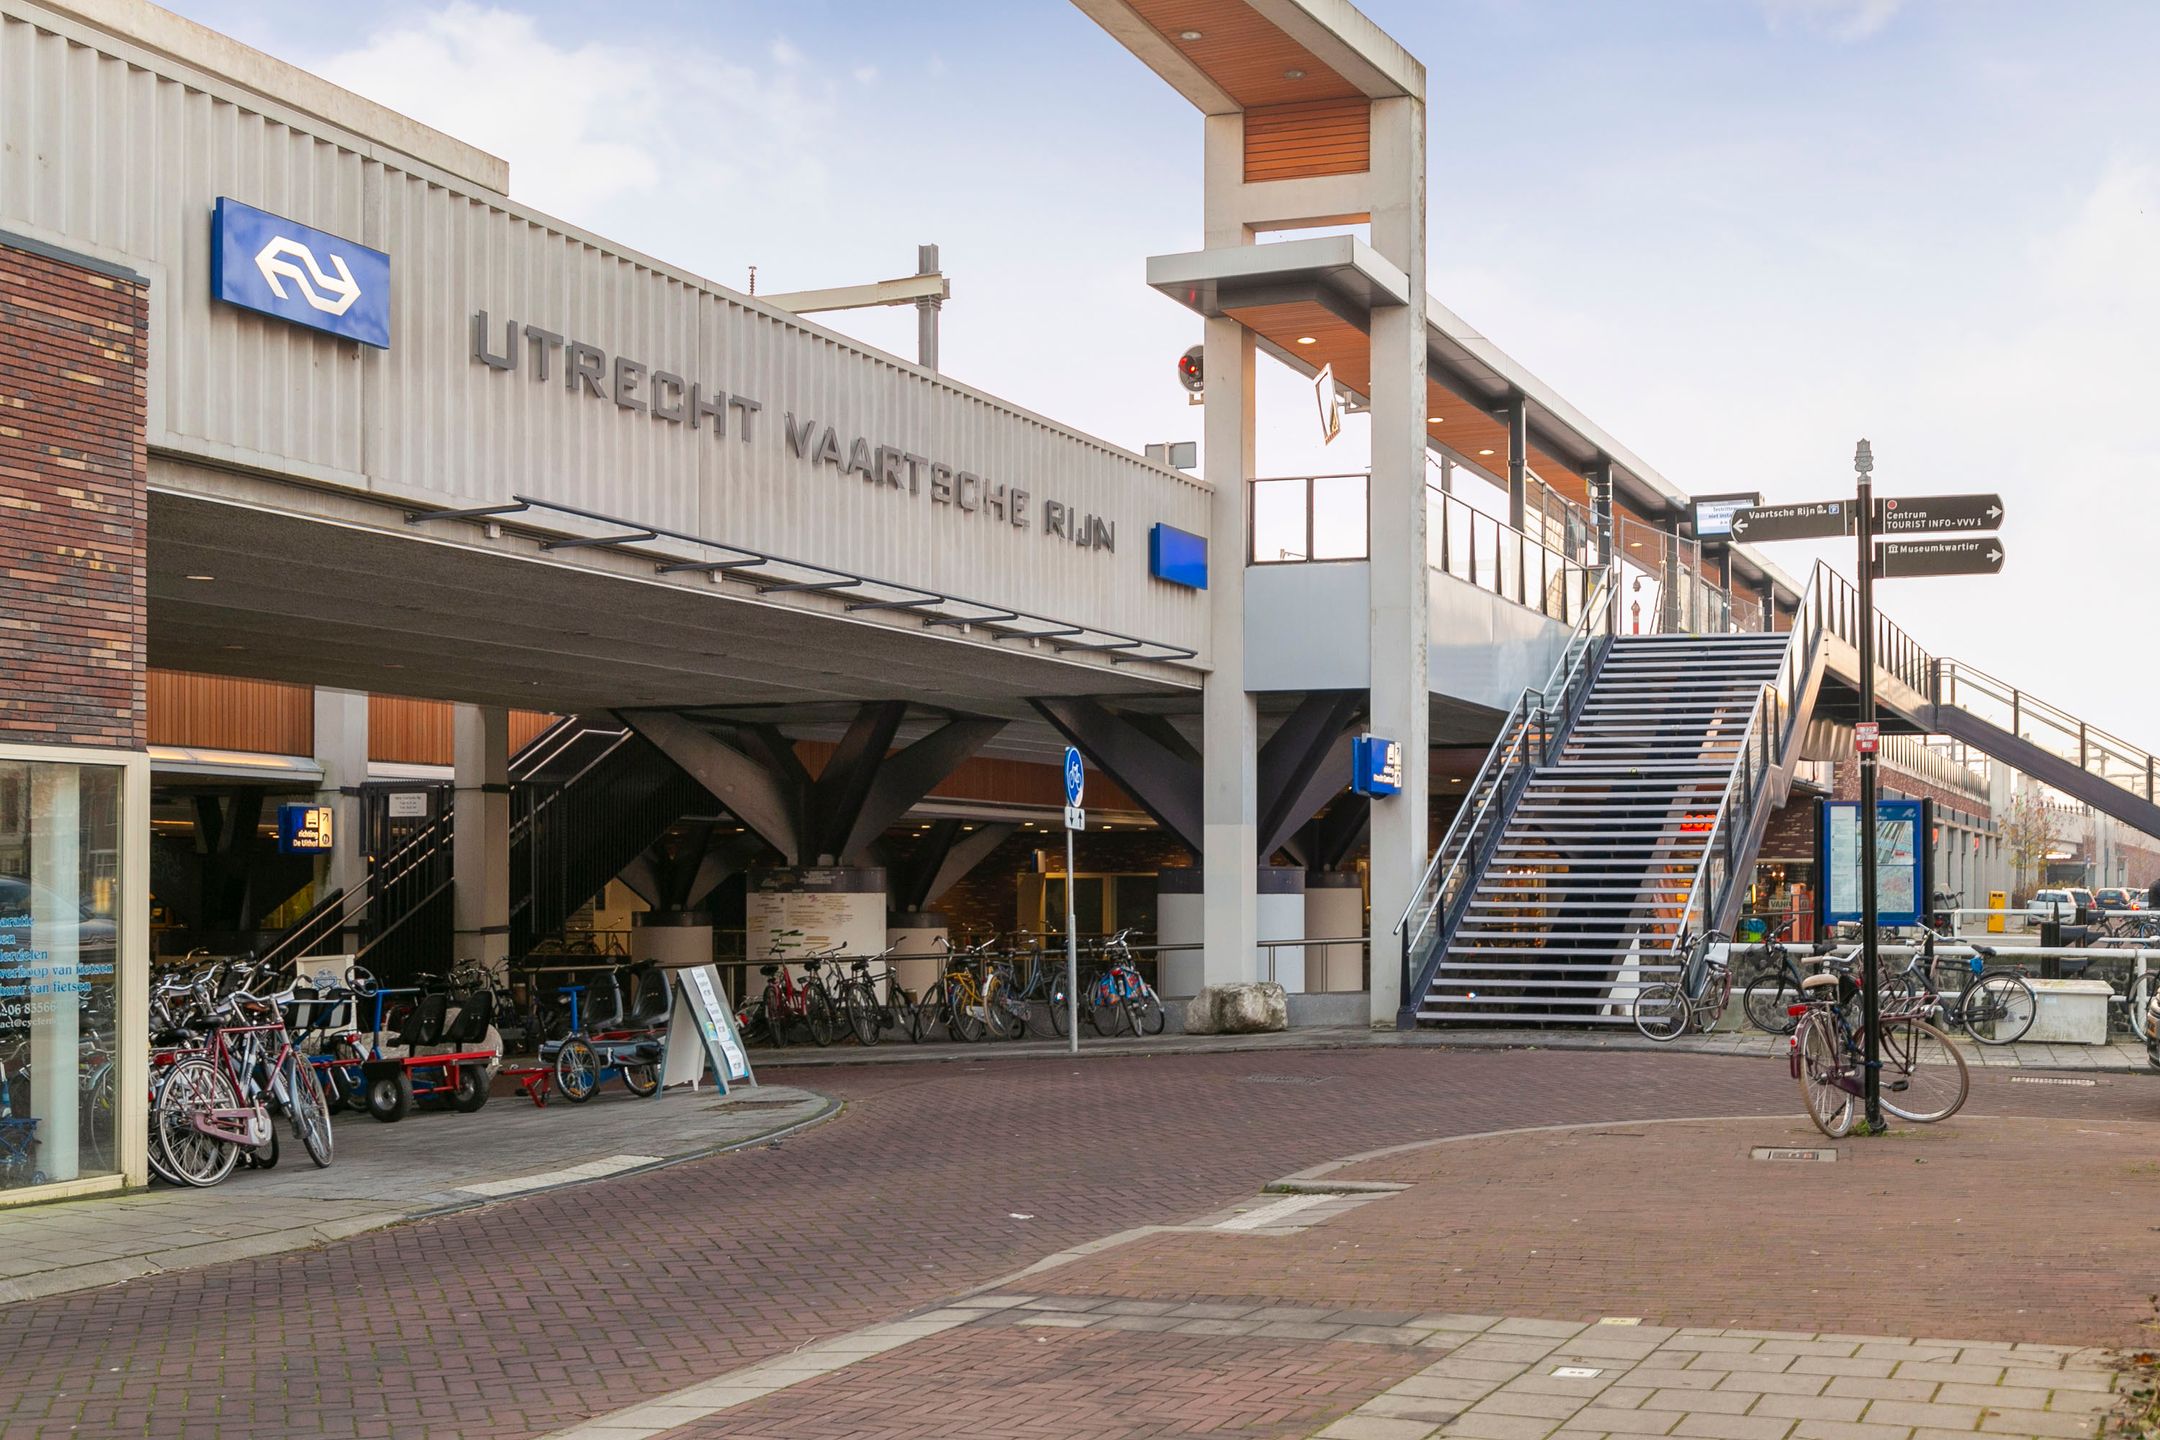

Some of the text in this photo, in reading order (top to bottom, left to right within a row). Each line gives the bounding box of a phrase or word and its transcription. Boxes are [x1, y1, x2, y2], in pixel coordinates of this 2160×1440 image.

[475, 309, 1115, 554] UTRECHT VAARTSCHE RIJN
[1748, 508, 1795, 519] Vaartsche
[1797, 506, 1816, 517] Rijn
[1886, 511, 1927, 520] Centrum
[1887, 520, 1926, 529] TOURIST
[1900, 542, 1980, 553] Museumkwartier
[52, 966, 72, 977] van
[29, 983, 49, 995] van
[53, 981, 92, 993] fietsen
